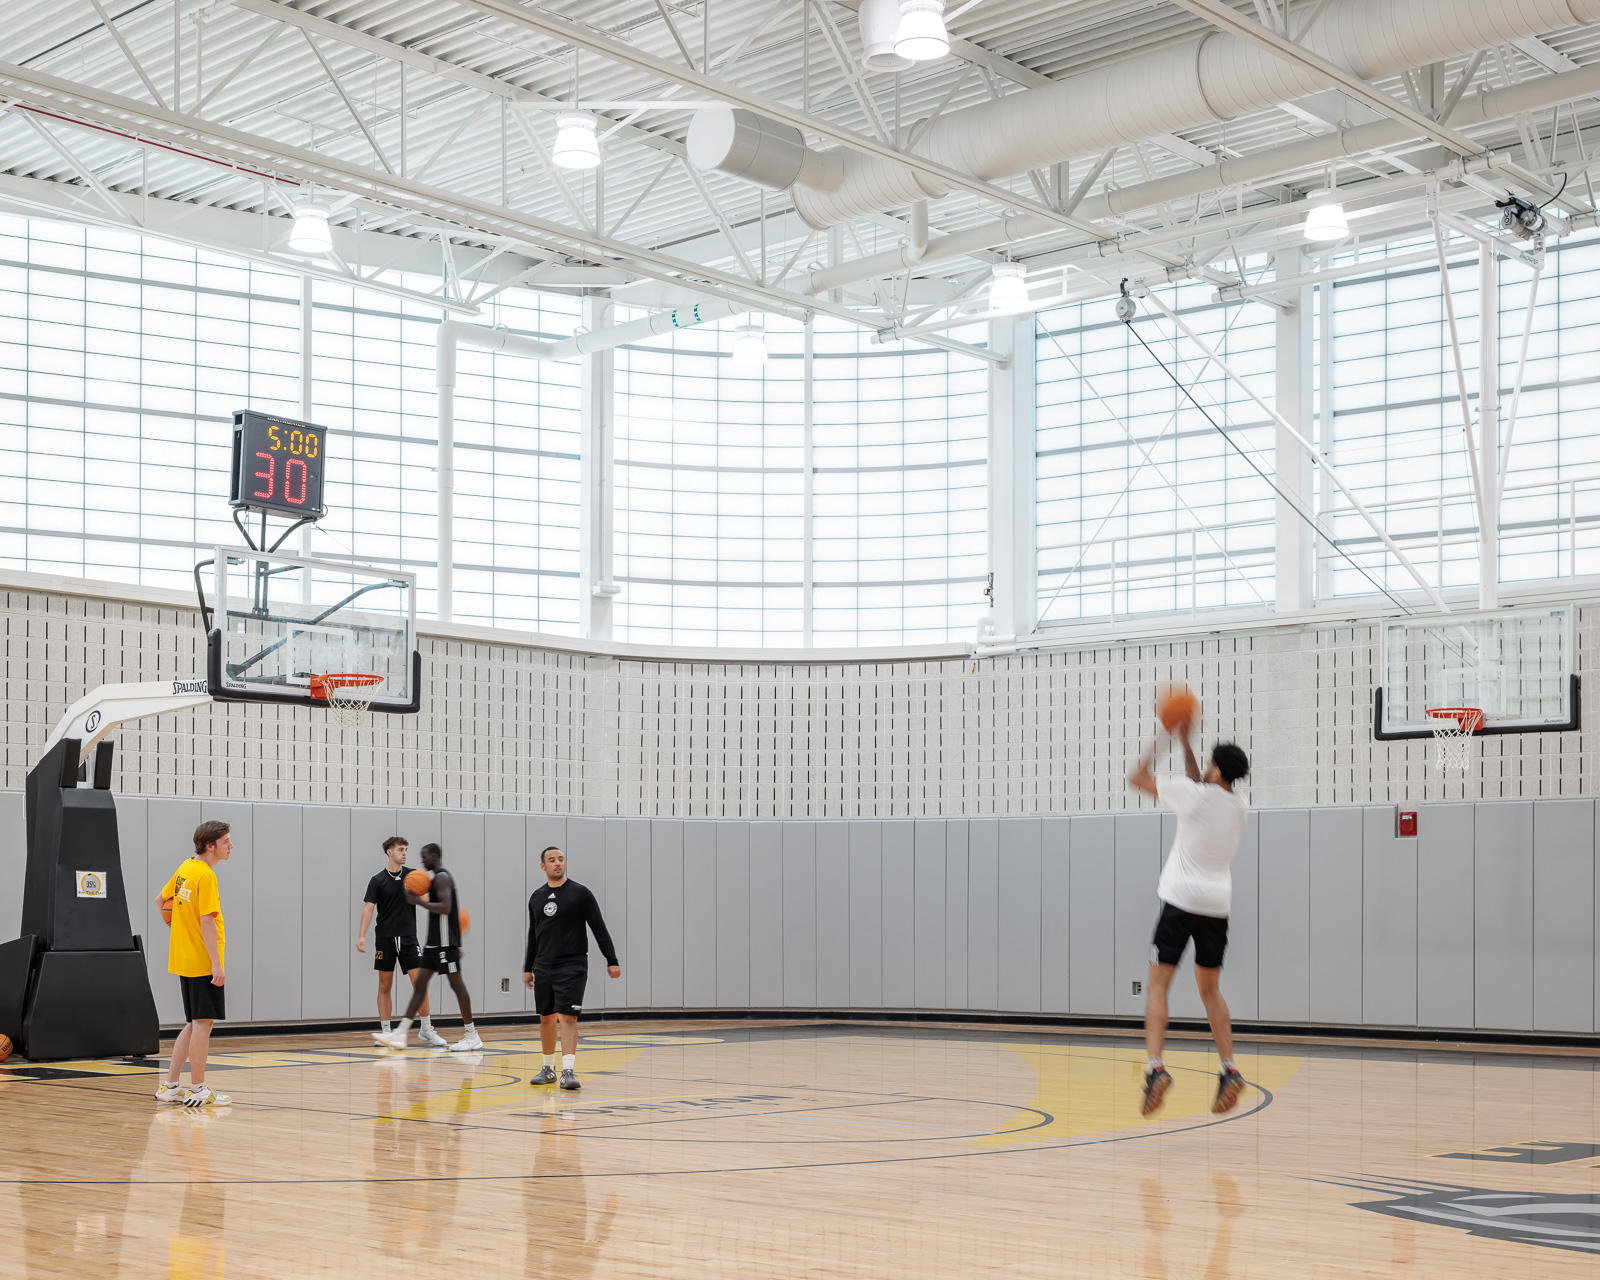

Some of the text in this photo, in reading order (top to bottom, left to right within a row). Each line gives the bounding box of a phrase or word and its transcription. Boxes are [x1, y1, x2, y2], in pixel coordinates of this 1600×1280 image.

[268, 425, 318, 458] 5:00
[254, 452, 307, 504] 30
[172, 680, 207, 695] SPALDING
[226, 682, 247, 690] SPALDING
